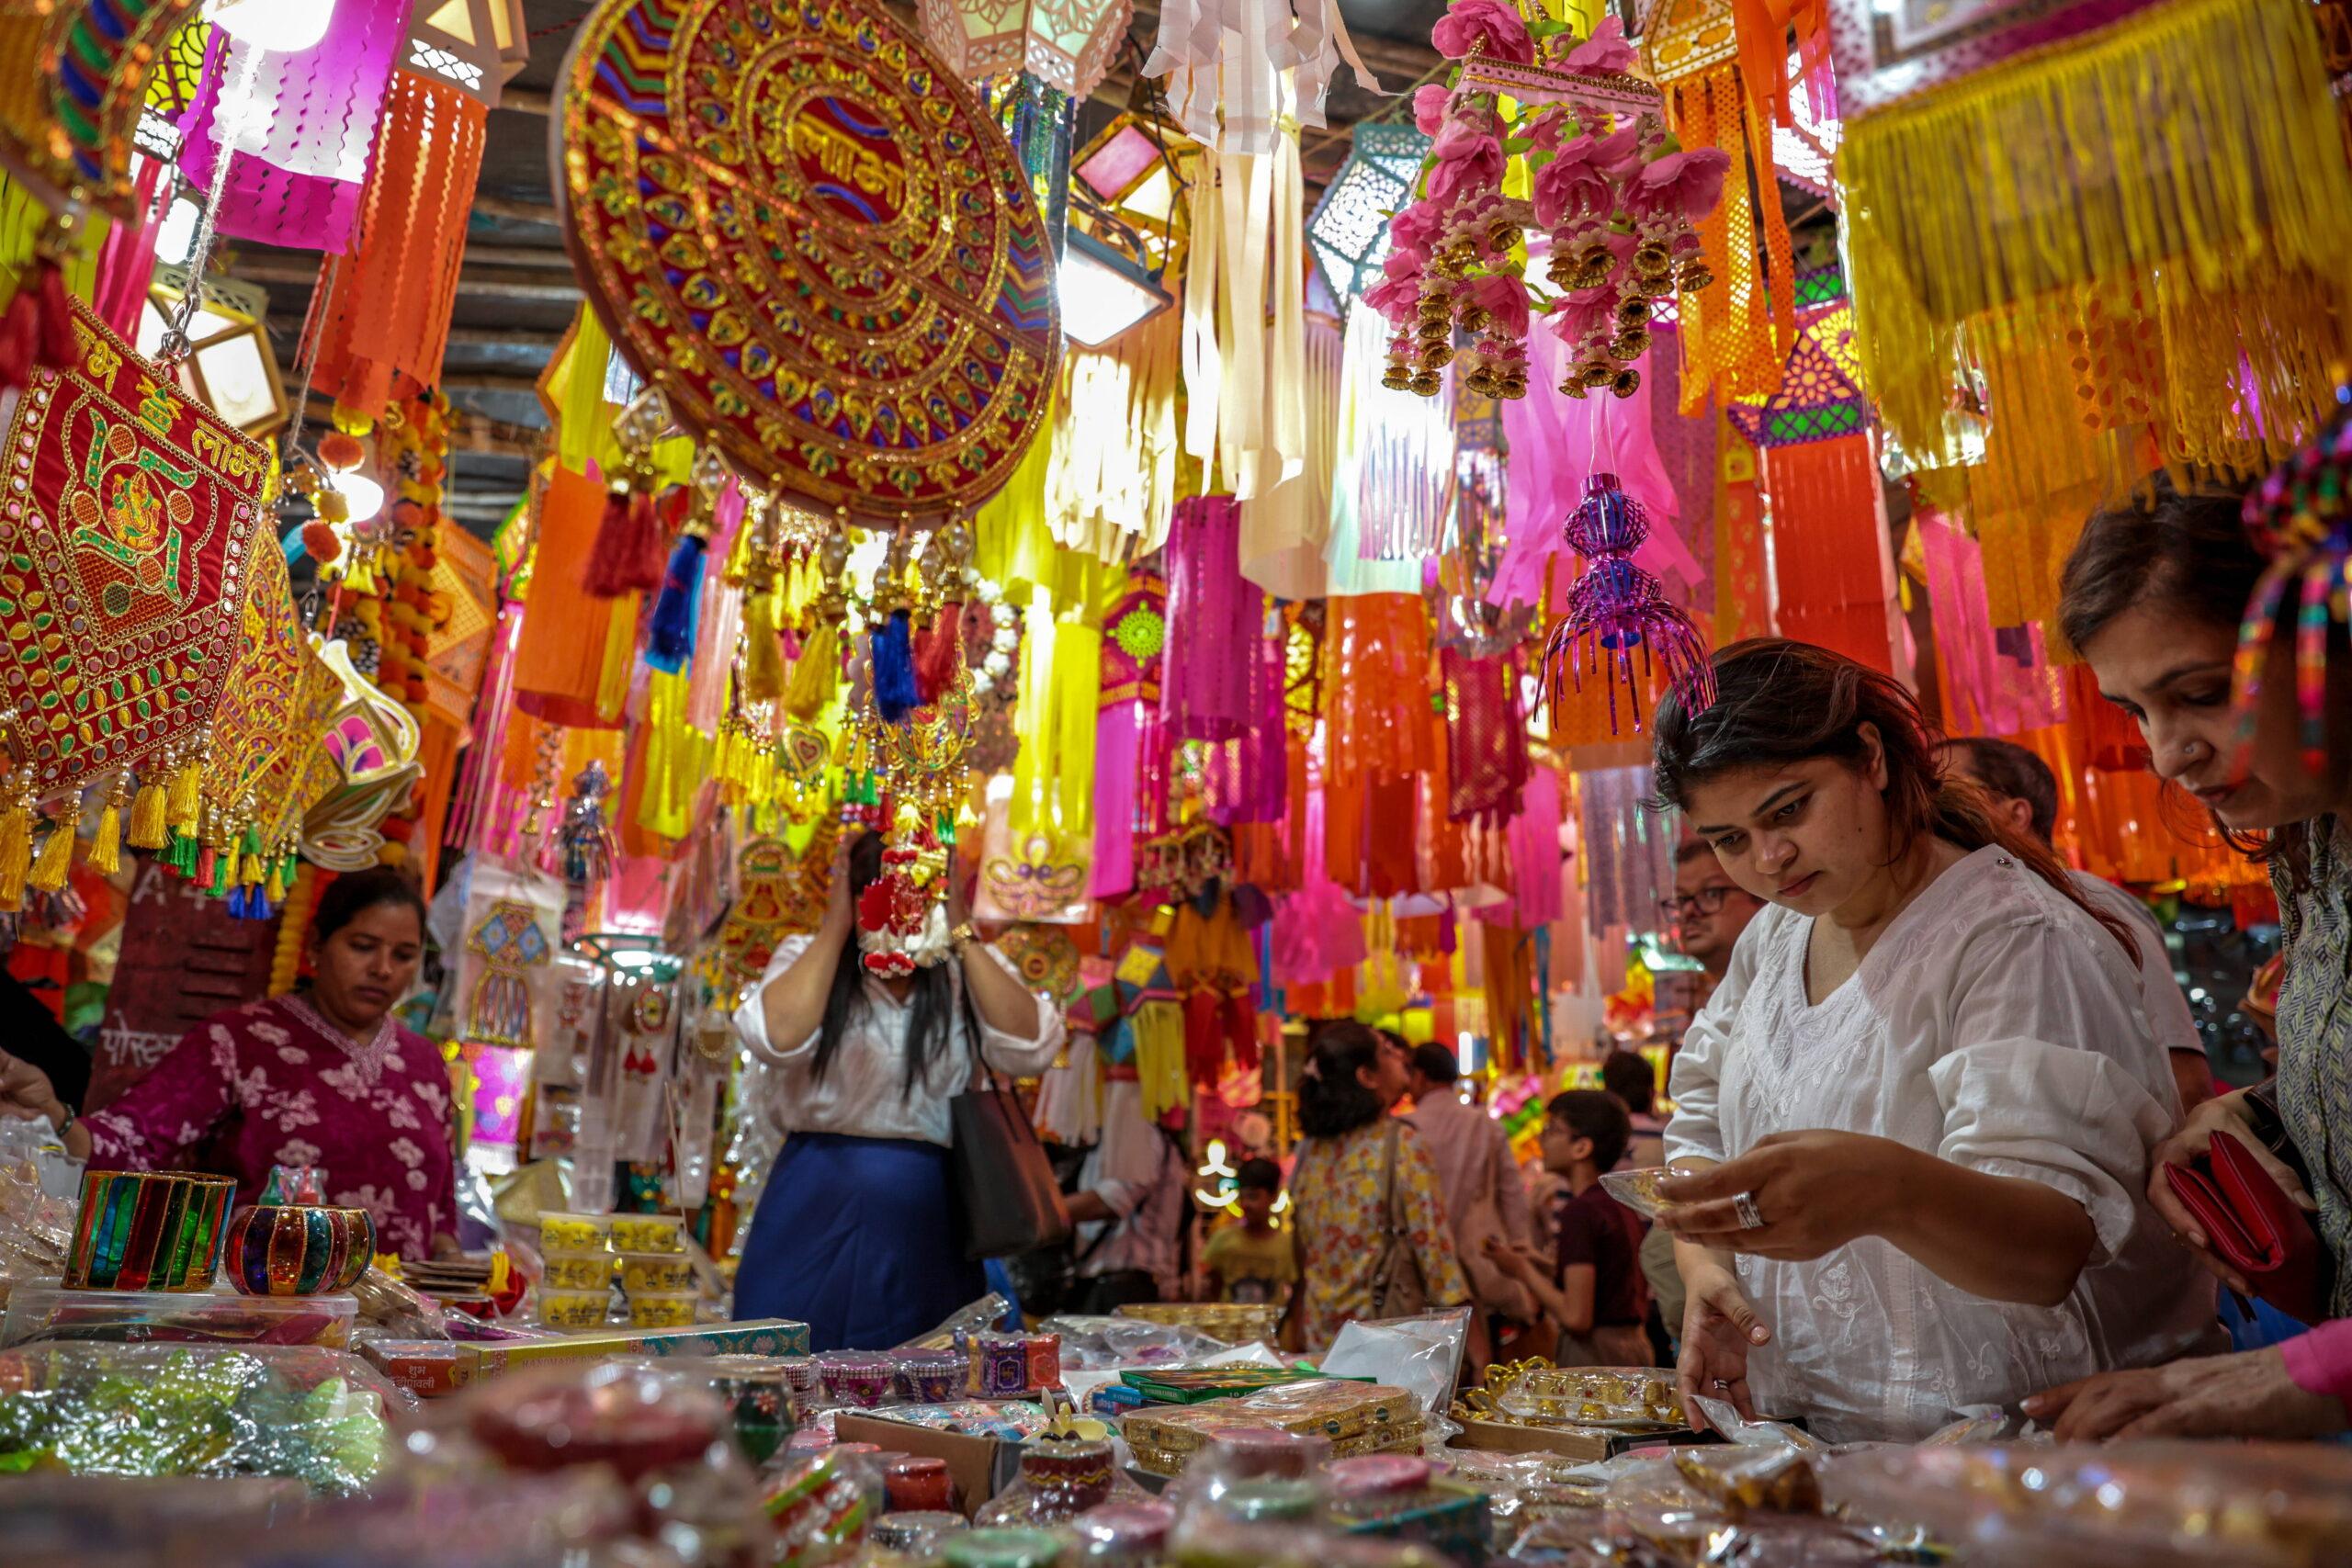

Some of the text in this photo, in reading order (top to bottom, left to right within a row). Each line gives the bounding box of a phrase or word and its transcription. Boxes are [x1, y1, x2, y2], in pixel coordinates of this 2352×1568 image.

[791, 111, 906, 210] लाभ
[191, 417, 263, 490] लाभ
[408, 1365, 427, 1379] शुभ
